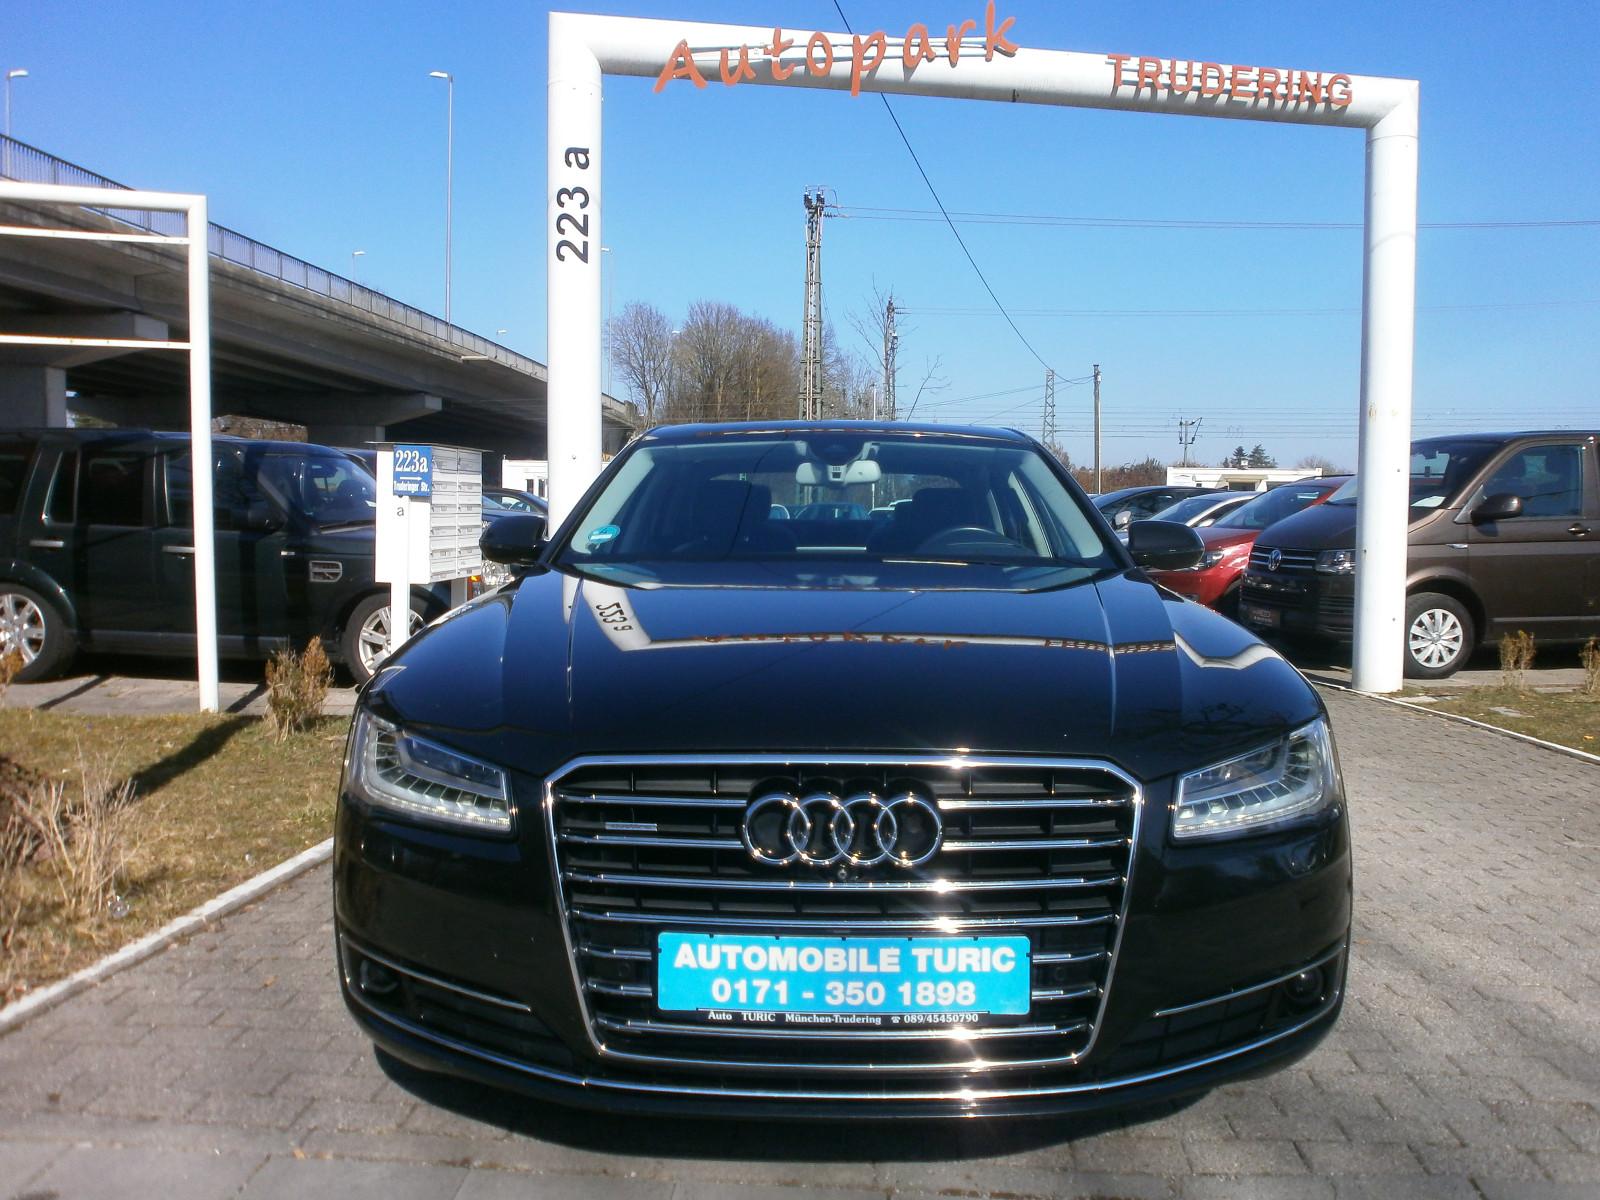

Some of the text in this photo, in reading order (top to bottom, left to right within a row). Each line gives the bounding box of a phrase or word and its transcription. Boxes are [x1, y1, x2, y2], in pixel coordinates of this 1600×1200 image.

[652, 0, 1019, 97] Autopark
[1107, 53, 1353, 106] TRUDERING
[556, 147, 589, 264] 223 a
[395, 450, 428, 473] 223a
[674, 943, 1016, 973] AUTOMOBILE TURIC
[711, 977, 788, 1005] 0171
[824, 980, 886, 1006] 350
[898, 980, 977, 1006] 1898
[708, 1011, 979, 1025] Auto TURIC München-Trudering 089/45450790
